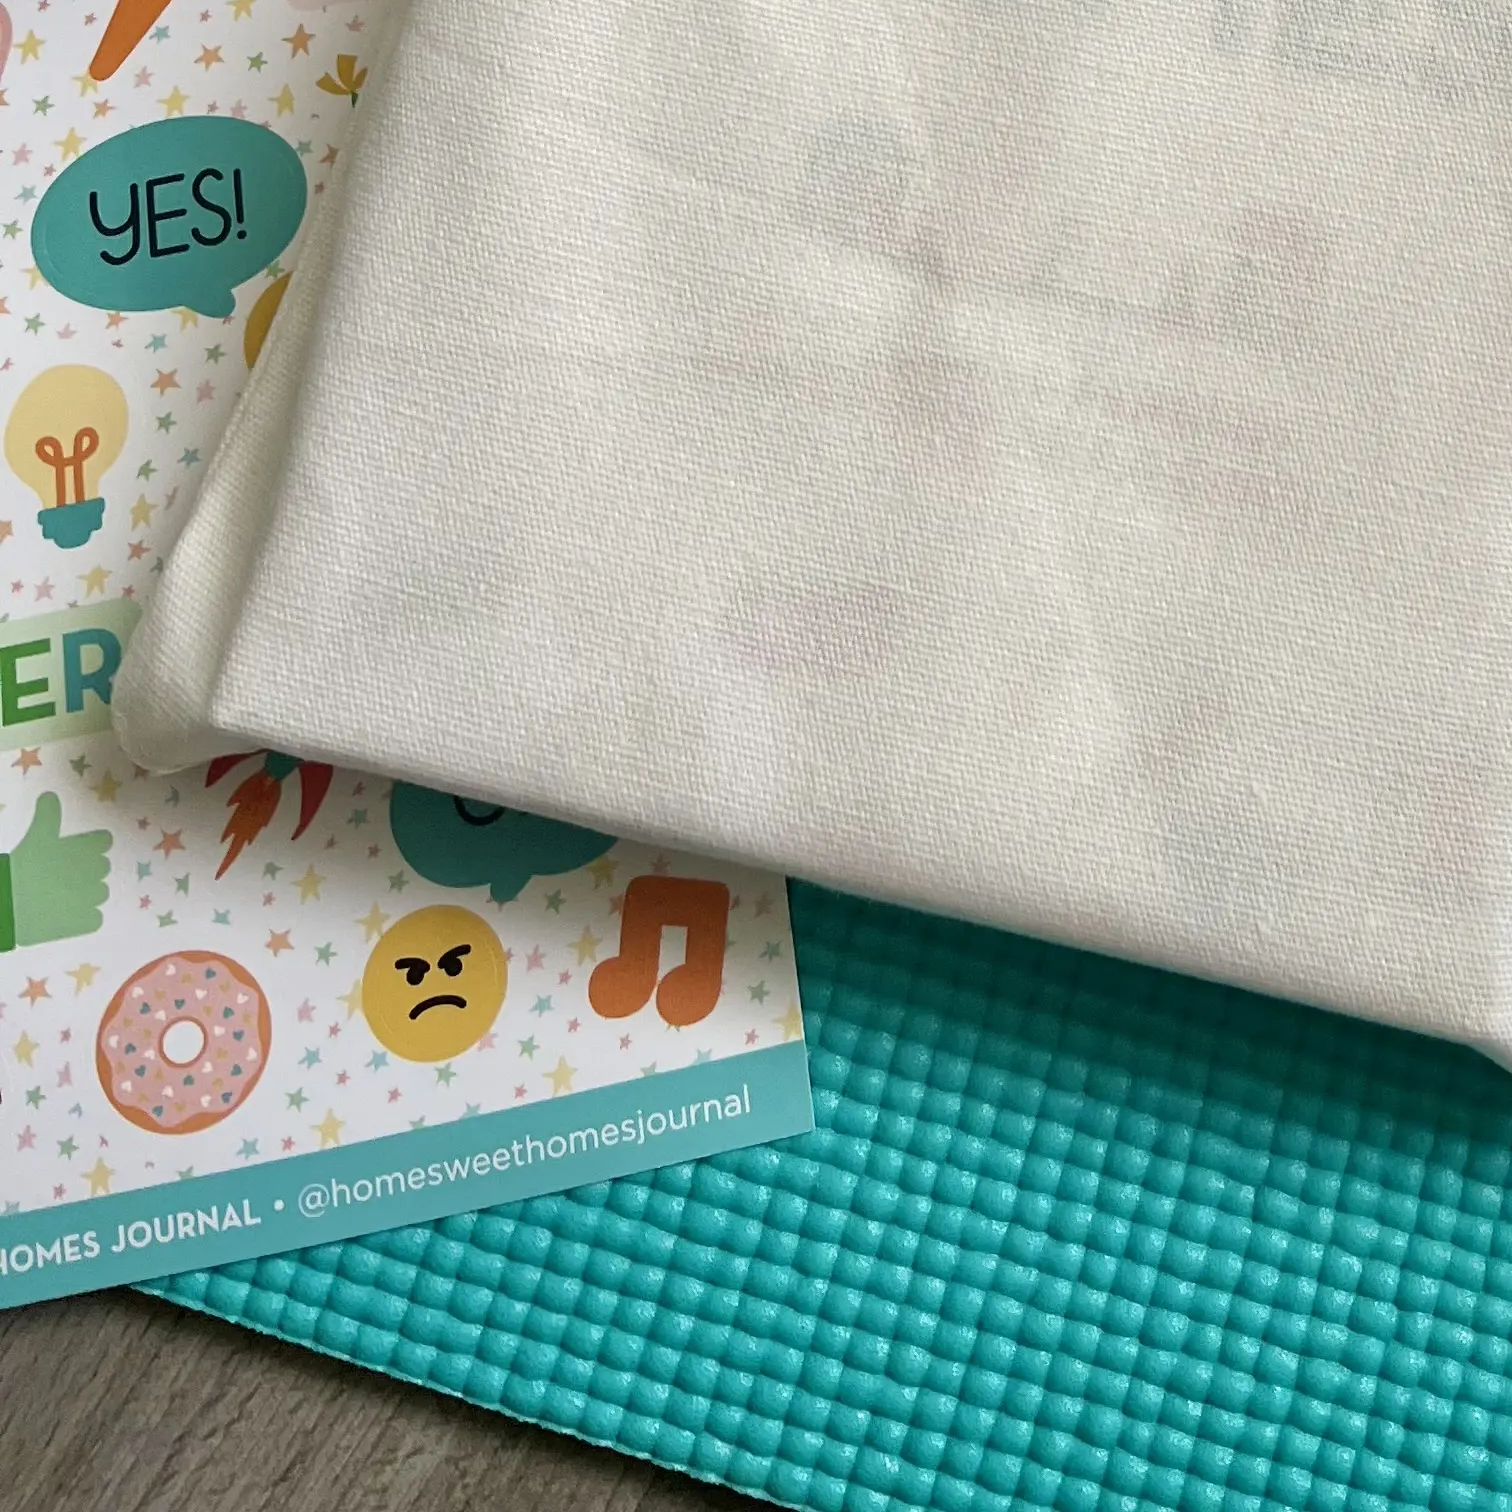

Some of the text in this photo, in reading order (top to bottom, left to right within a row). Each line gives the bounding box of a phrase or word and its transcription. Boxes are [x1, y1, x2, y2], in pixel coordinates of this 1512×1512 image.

[88, 167, 249, 266] YES!
[111, 1198, 262, 1254] JOURNAL
[297, 1083, 752, 1219] @homesweethomesjournal
